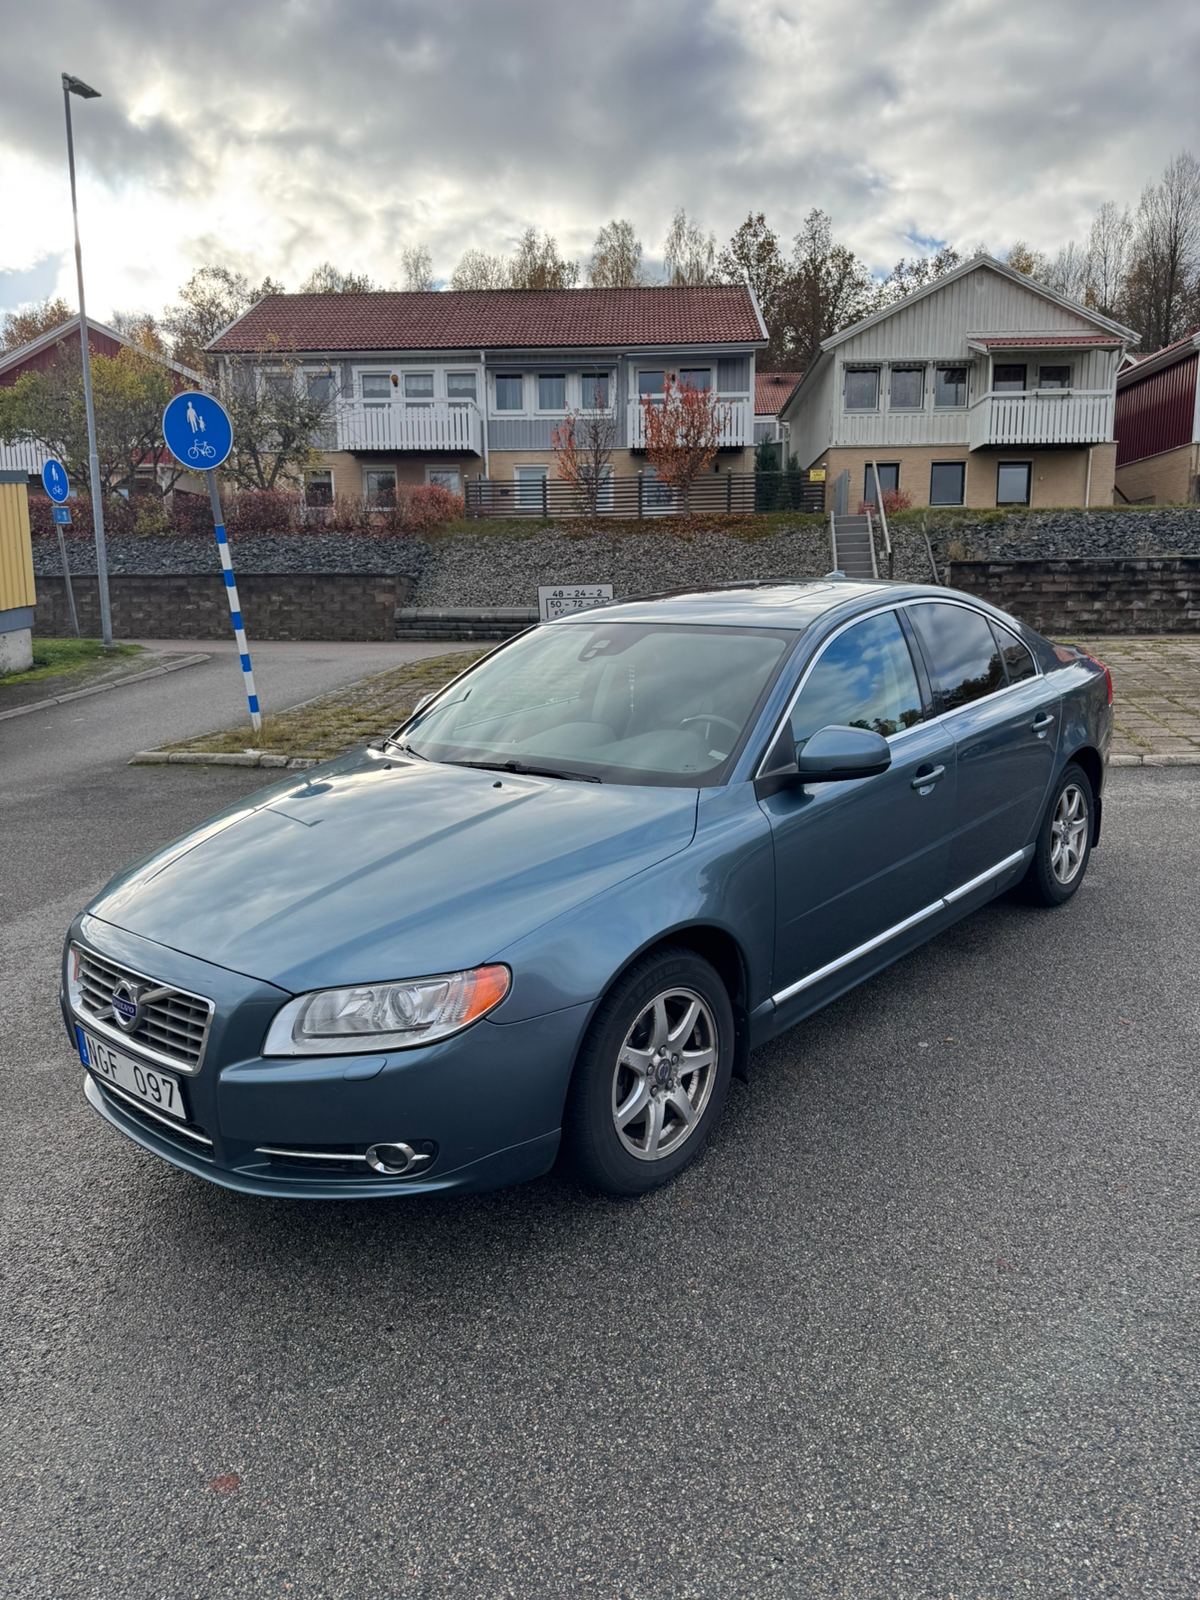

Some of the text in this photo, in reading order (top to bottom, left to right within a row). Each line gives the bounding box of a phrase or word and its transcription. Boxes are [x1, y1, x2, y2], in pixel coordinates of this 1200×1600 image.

[574, 589, 586, 597] 24
[596, 589, 602, 597] 2
[113, 997, 135, 1014] VOLVO
[86, 1035, 174, 1108] NGF 097
